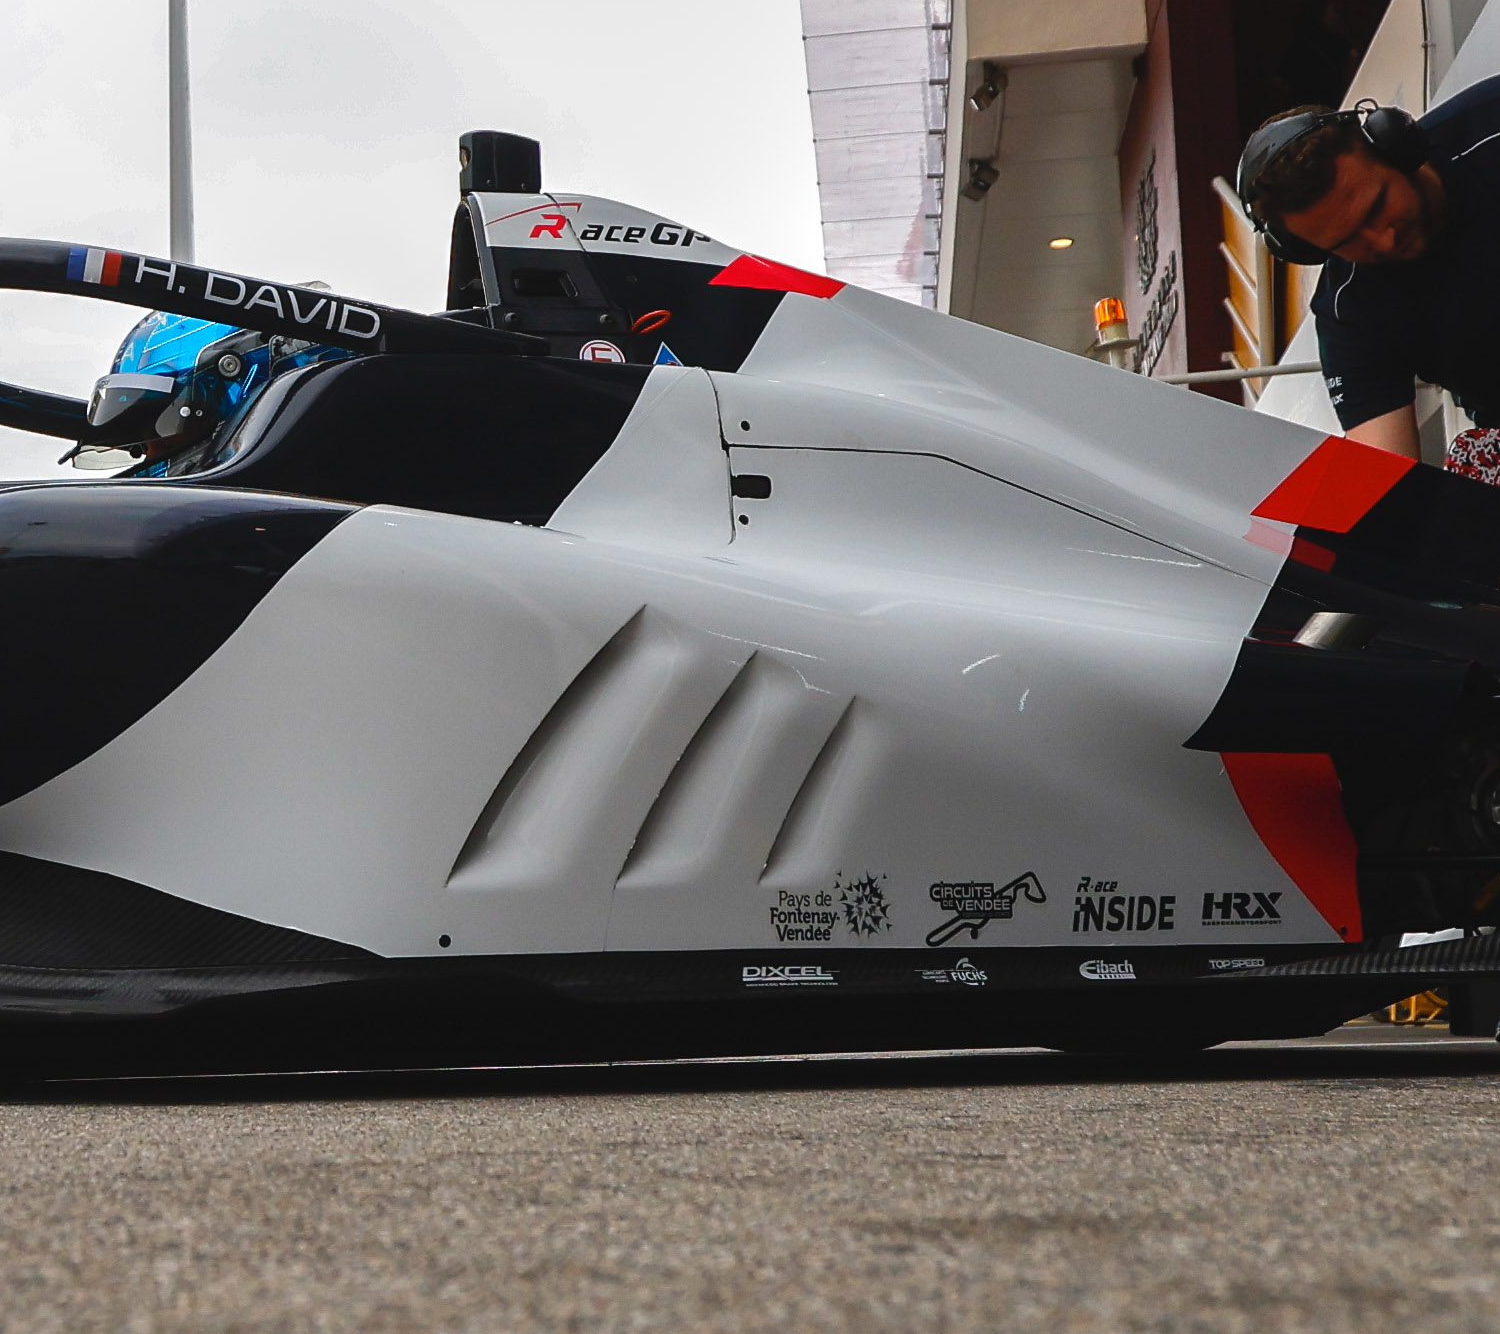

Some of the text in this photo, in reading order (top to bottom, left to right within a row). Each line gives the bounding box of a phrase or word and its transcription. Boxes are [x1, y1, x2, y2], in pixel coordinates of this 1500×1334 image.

[134, 255, 381, 340] H. DAVID
[931, 883, 993, 899] CIRCUITS
[778, 890, 832, 910] Pays de
[955, 896, 1011, 911] VENDÉE
[1202, 892, 1283, 920] HRX
[776, 923, 831, 942] Vendée
[1079, 959, 1134, 980] Eibach
[1208, 958, 1265, 970] TOP SPEED
[742, 966, 833, 981] DIXCEL
[951, 969, 988, 983] FUCHS
